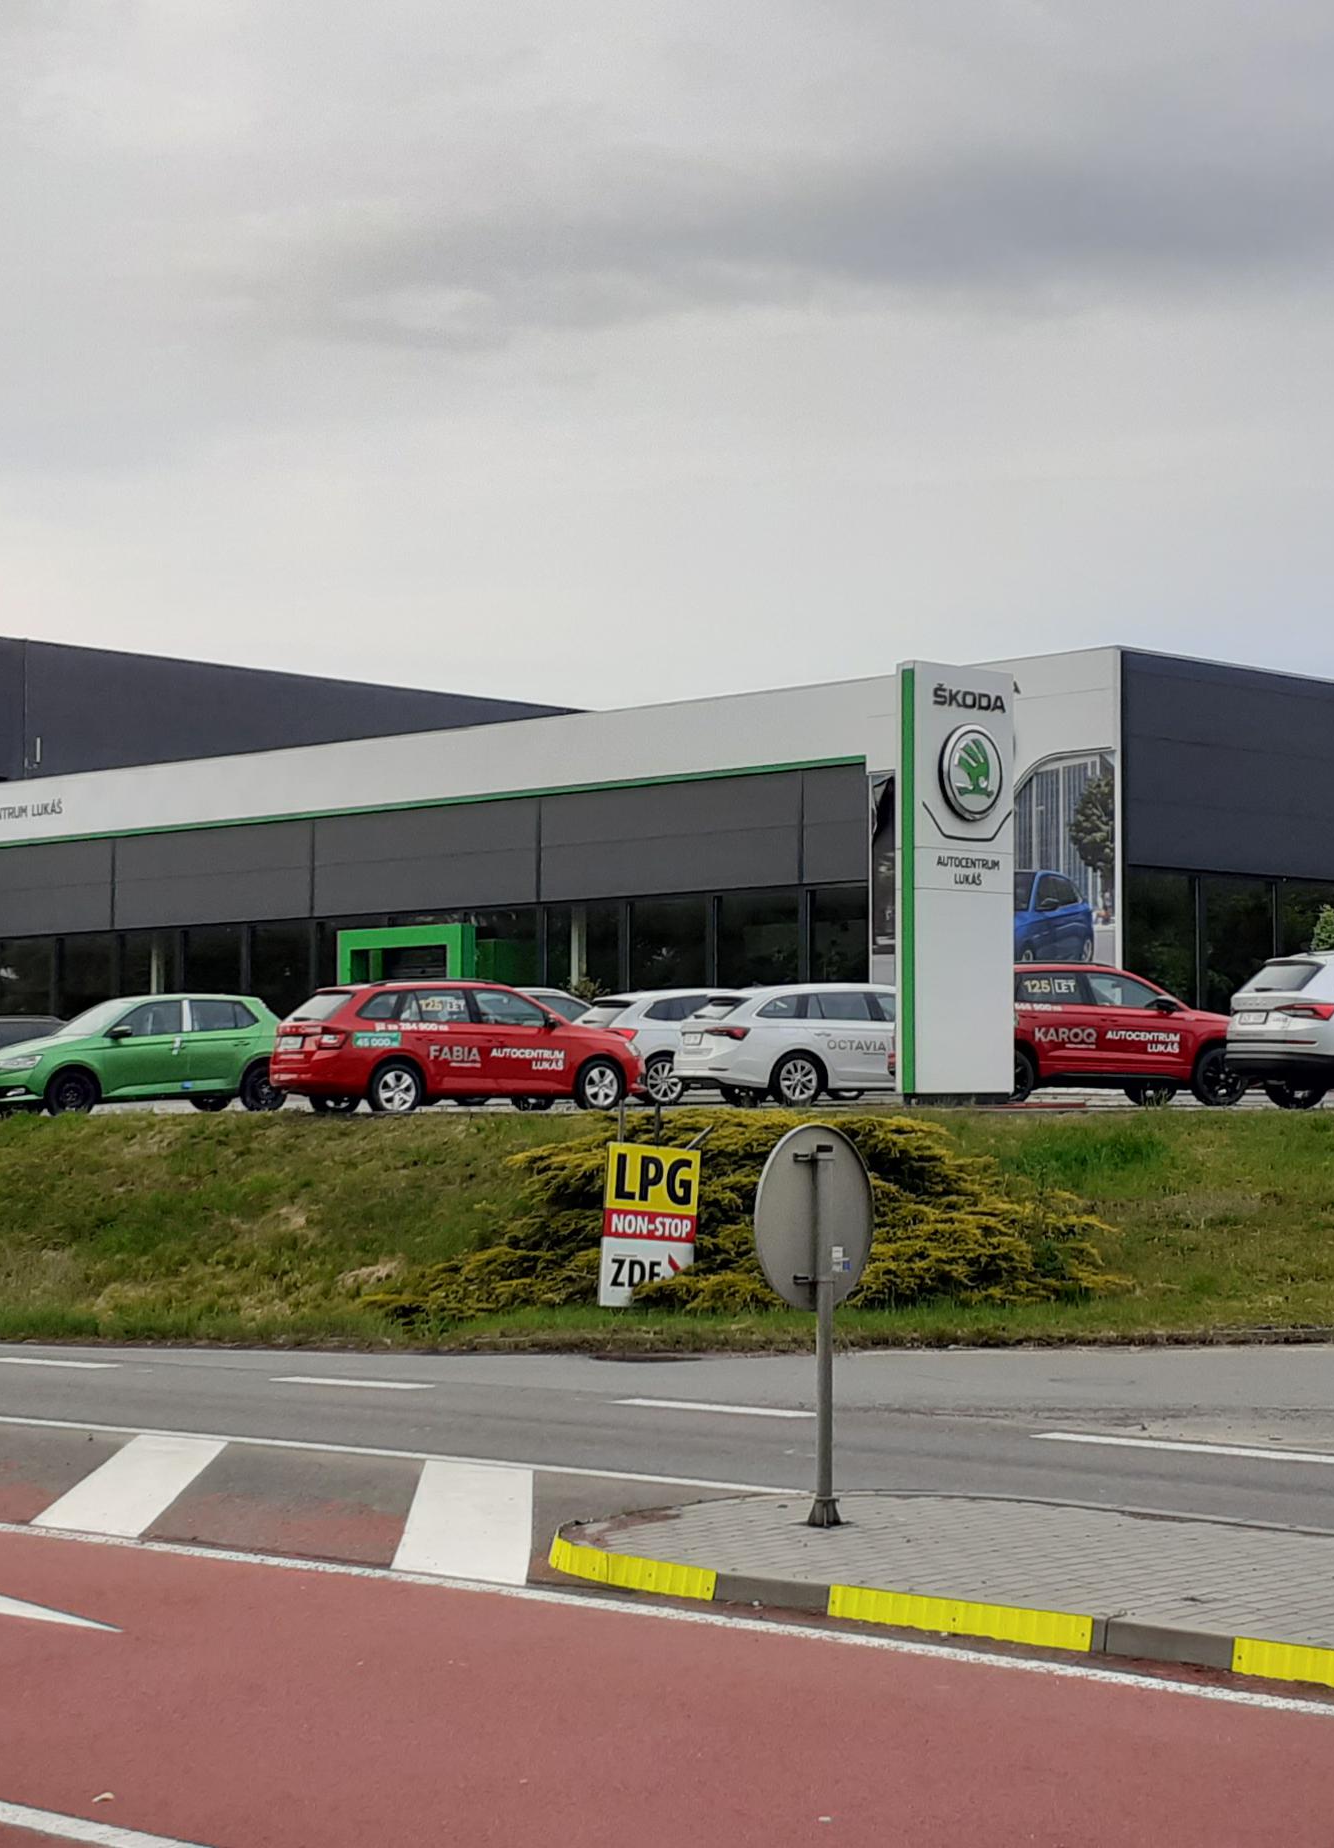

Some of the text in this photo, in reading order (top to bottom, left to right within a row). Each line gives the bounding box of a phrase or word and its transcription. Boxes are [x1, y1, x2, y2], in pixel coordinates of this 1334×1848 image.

[932, 683, 1006, 713] ŠKODA
[31, 798, 63, 817] LUKÁŠ
[936, 856, 1000, 871] AUTOCENTRUM
[954, 873, 982, 886] LUKÁŠ
[1024, 979, 1075, 993] 125 LET
[1034, 1027, 1097, 1043] KAROQ
[1105, 1030, 1180, 1042] AUTOCENTRUM
[429, 1045, 481, 1061] FABIA
[827, 1040, 887, 1052] OCTAVIA
[1147, 1042, 1180, 1054] LUKÁŠ
[490, 1048, 565, 1059] AUTOCENTRUM
[531, 1059, 564, 1071] LUKÁŠ
[615, 1152, 693, 1207] LPG
[611, 1213, 692, 1238] NON-STOP
